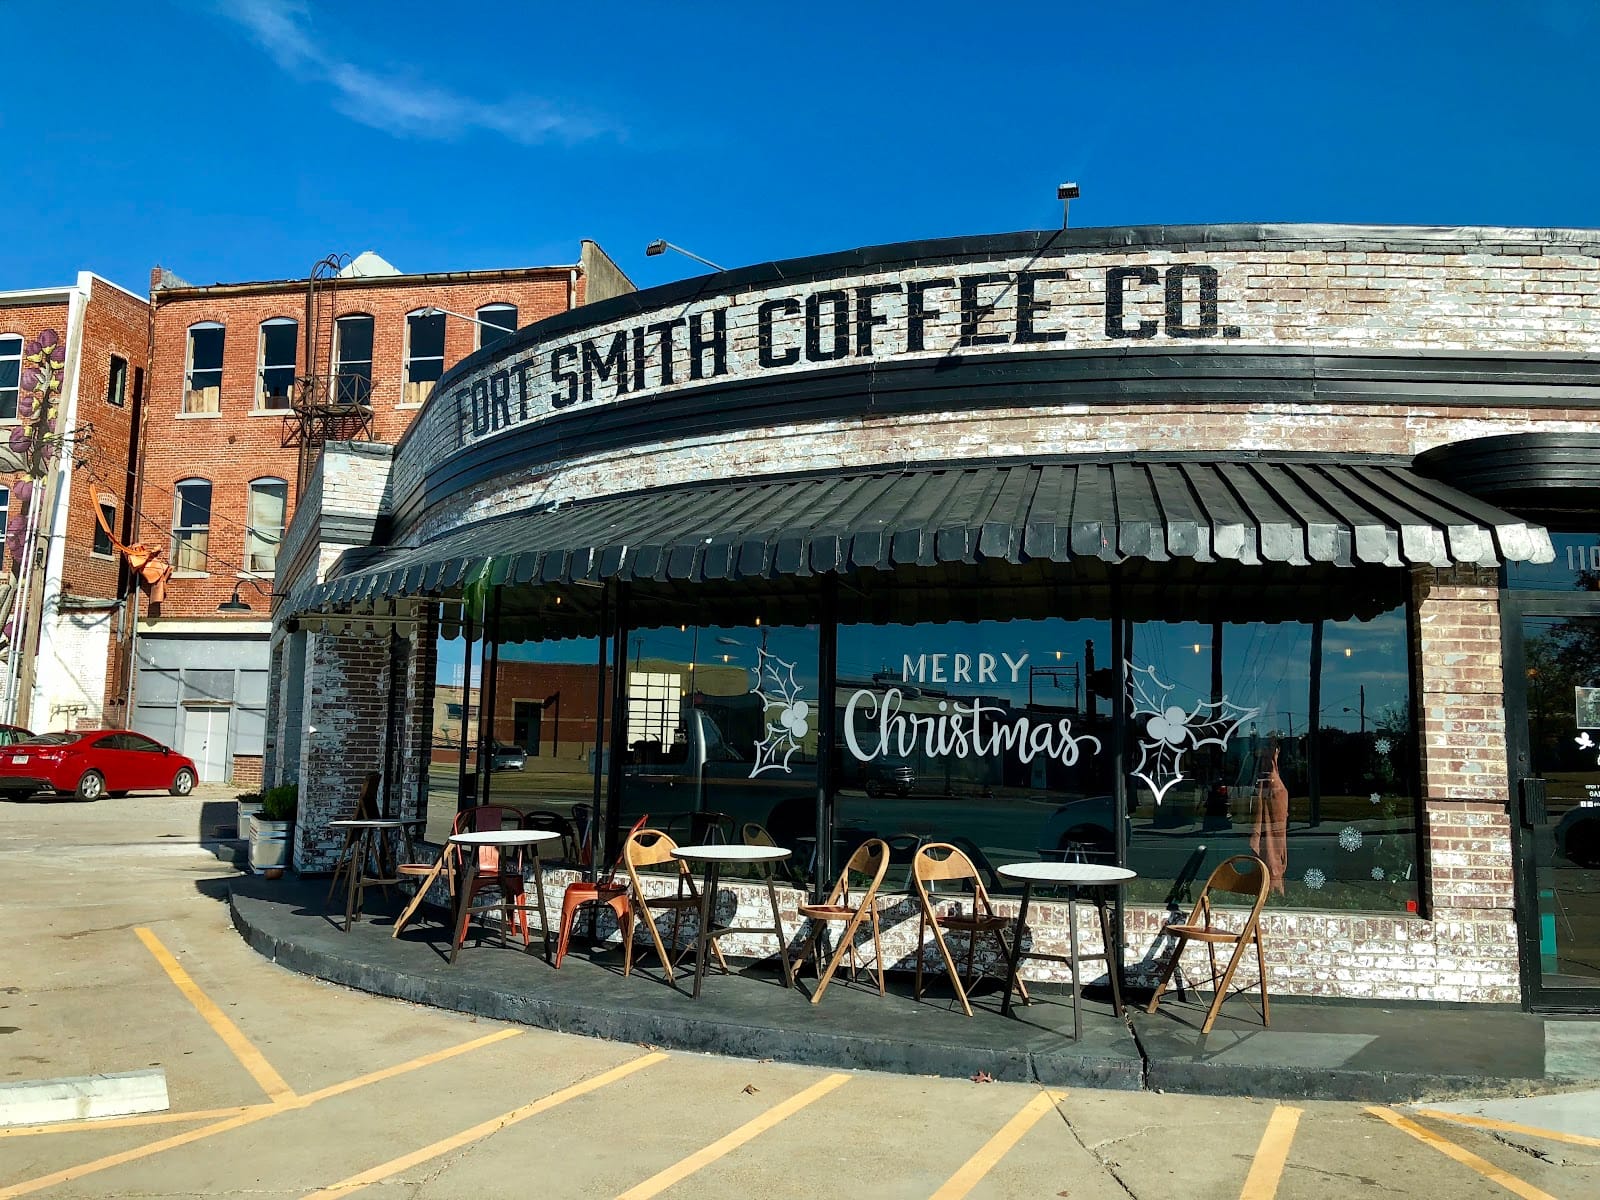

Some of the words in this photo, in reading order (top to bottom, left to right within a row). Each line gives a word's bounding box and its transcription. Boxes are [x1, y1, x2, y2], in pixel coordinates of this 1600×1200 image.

[455, 359, 534, 449] FORT
[551, 307, 728, 410] SMITH
[758, 270, 1068, 369] COFFEE
[1105, 265, 1241, 339] CO.
[902, 652, 1030, 683] MERRY
[844, 688, 1101, 767] Christmas
